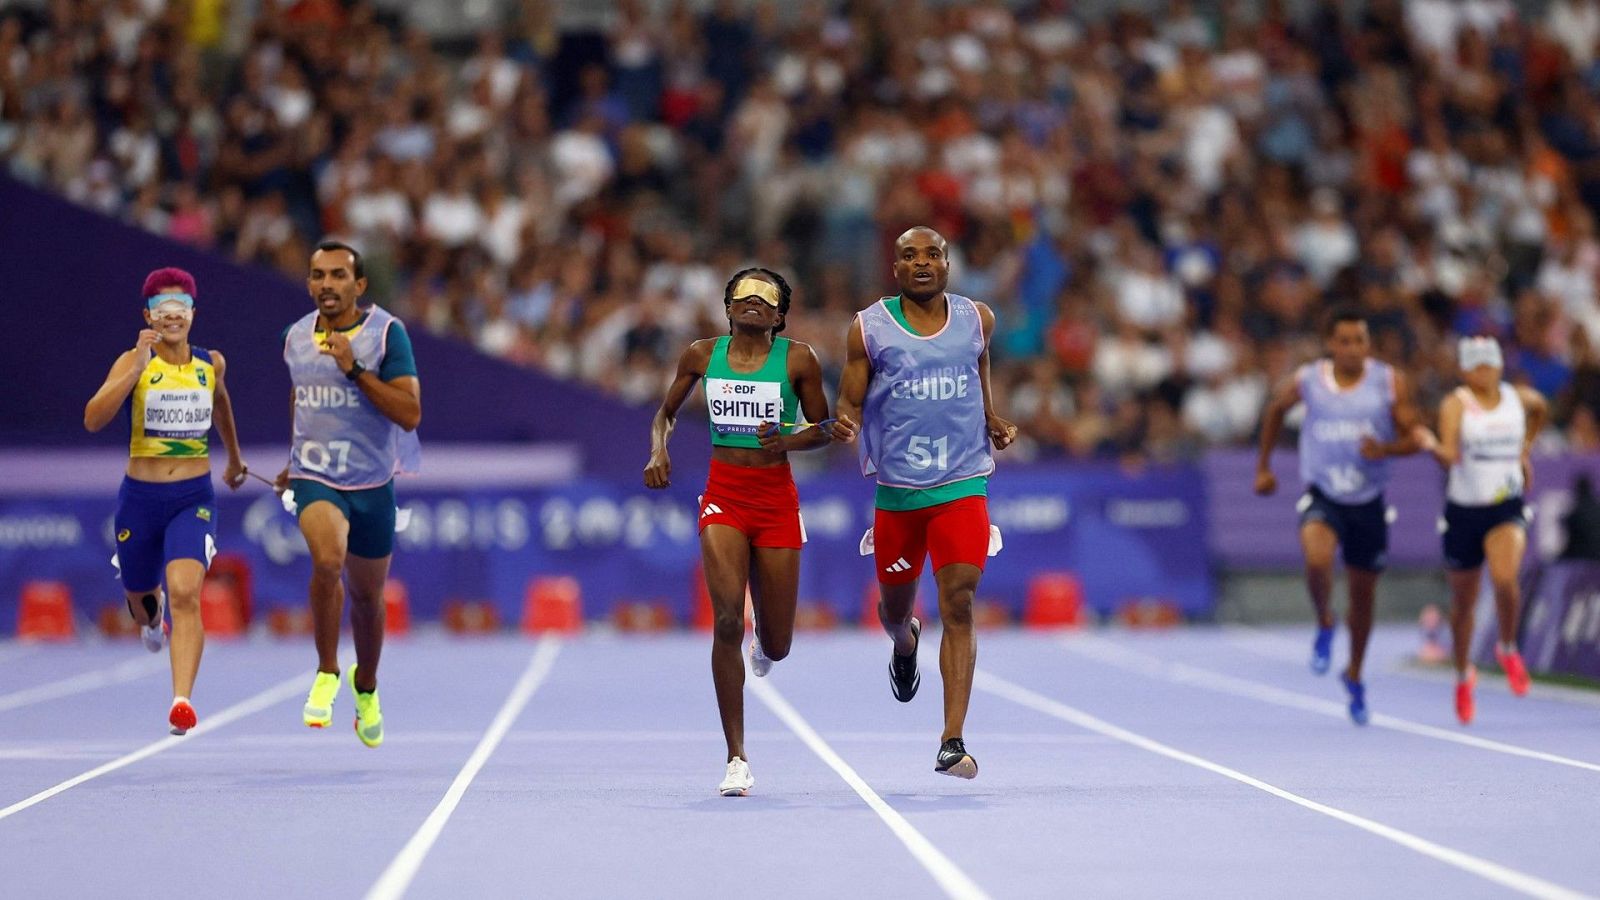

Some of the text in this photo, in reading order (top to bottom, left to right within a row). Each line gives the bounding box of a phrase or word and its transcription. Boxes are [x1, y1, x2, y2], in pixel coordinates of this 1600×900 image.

[160, 393, 188, 402] Allianz
[295, 385, 360, 408] GUIDE
[890, 374, 968, 401] GUIDE
[146, 407, 184, 424] SIMPLICIO
[710, 399, 775, 418] SHITILE
[300, 440, 352, 474] 07
[904, 435, 948, 471] 51
